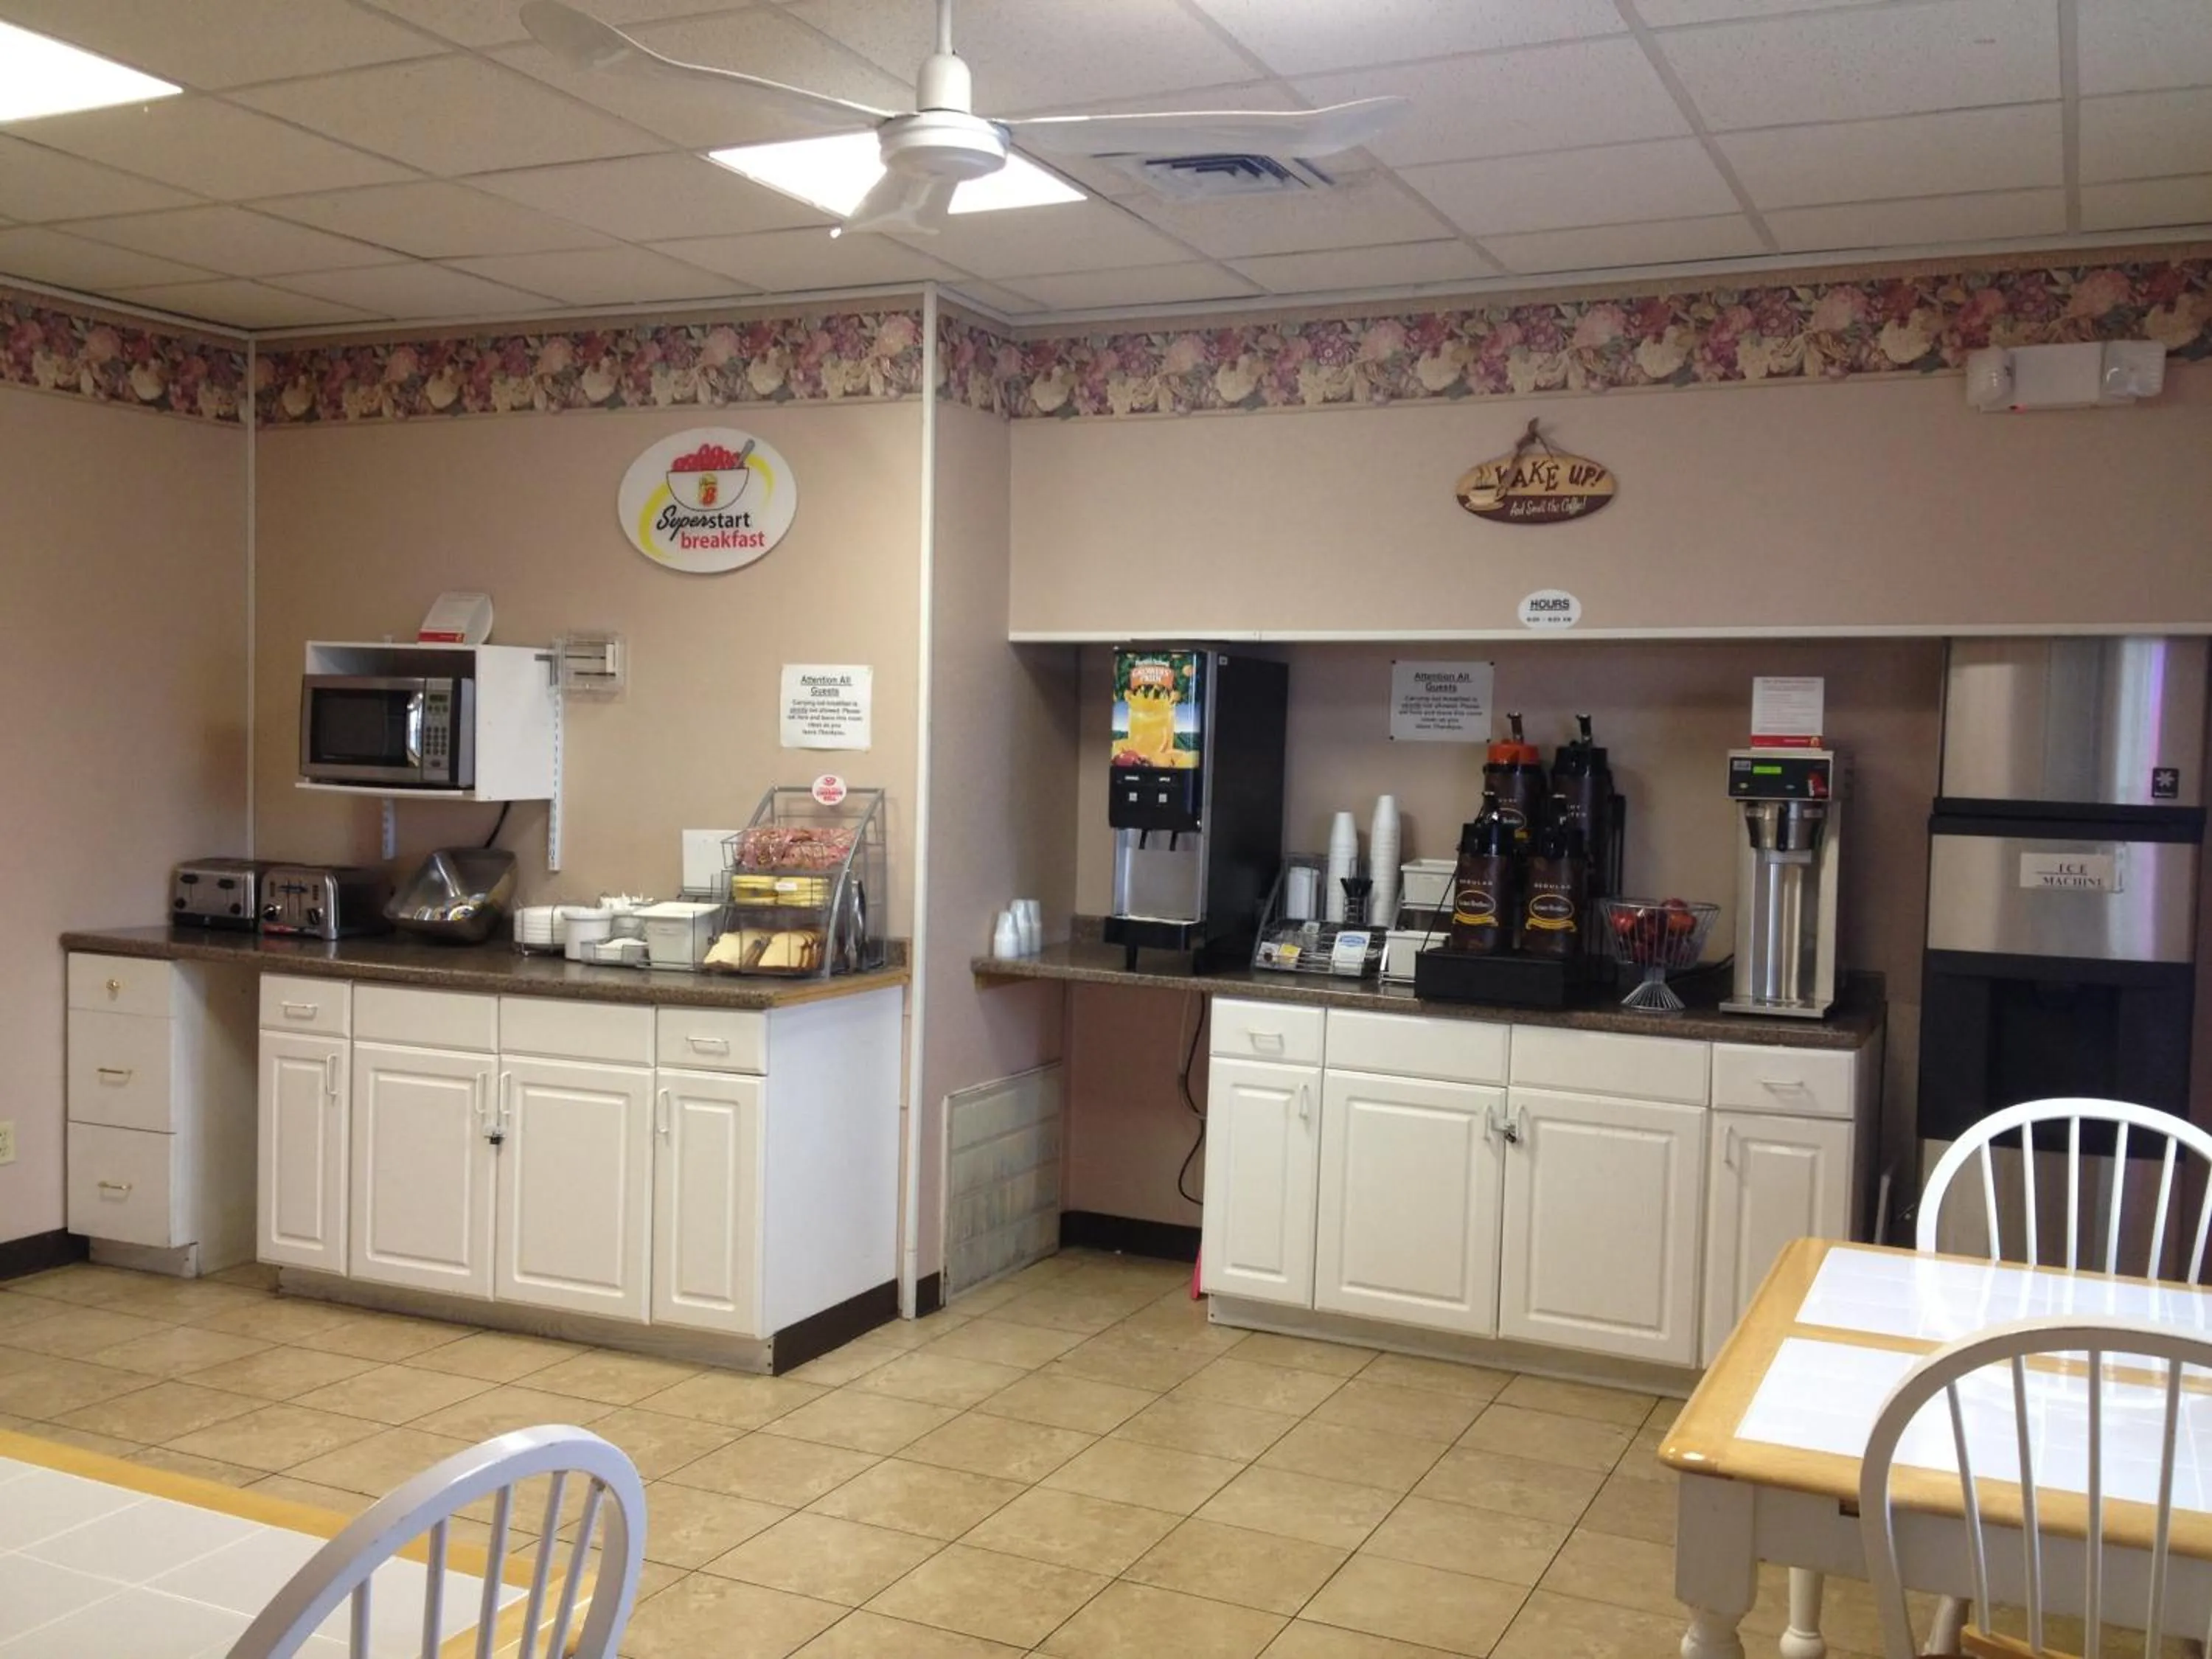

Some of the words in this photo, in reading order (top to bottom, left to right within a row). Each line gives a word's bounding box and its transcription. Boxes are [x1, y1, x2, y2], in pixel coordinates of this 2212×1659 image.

[1569, 464, 1606, 488] UP!
[657, 504, 751, 541] Superstart
[681, 530, 765, 549] breakfast
[1530, 598, 1570, 611] HOURS
[801, 674, 838, 686] Attention
[1415, 672, 1455, 682] Attention
[810, 686, 840, 697] Guests
[1426, 682, 1457, 692] Guests
[2059, 863, 2088, 874] ICE
[2042, 876, 2101, 886] MACHINE
